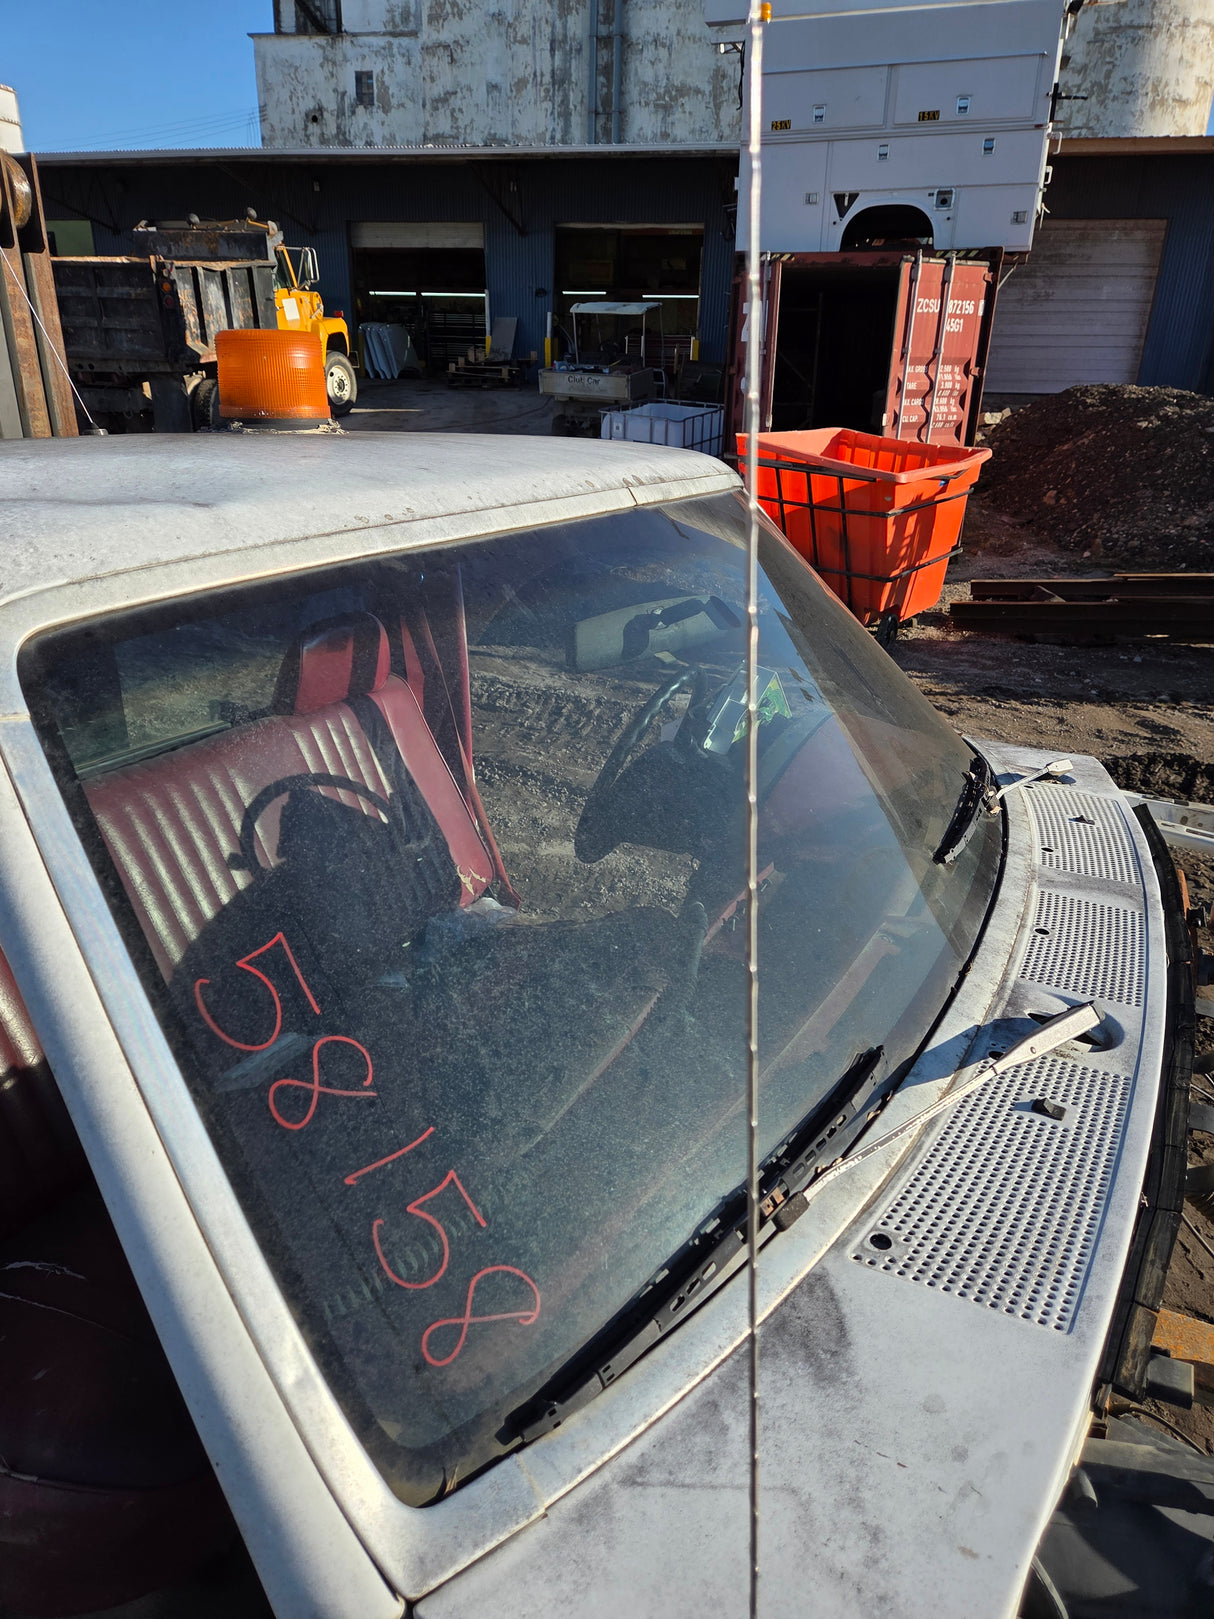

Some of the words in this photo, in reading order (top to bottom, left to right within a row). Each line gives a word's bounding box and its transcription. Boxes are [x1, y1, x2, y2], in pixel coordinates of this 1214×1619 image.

[918, 110, 940, 121] 15KV
[771, 120, 791, 131] 25KV
[917, 298, 941, 313] ZCSU
[945, 318, 964, 333] 45G1
[587, 376, 601, 385] Car
[194, 931, 542, 1368] 58158
